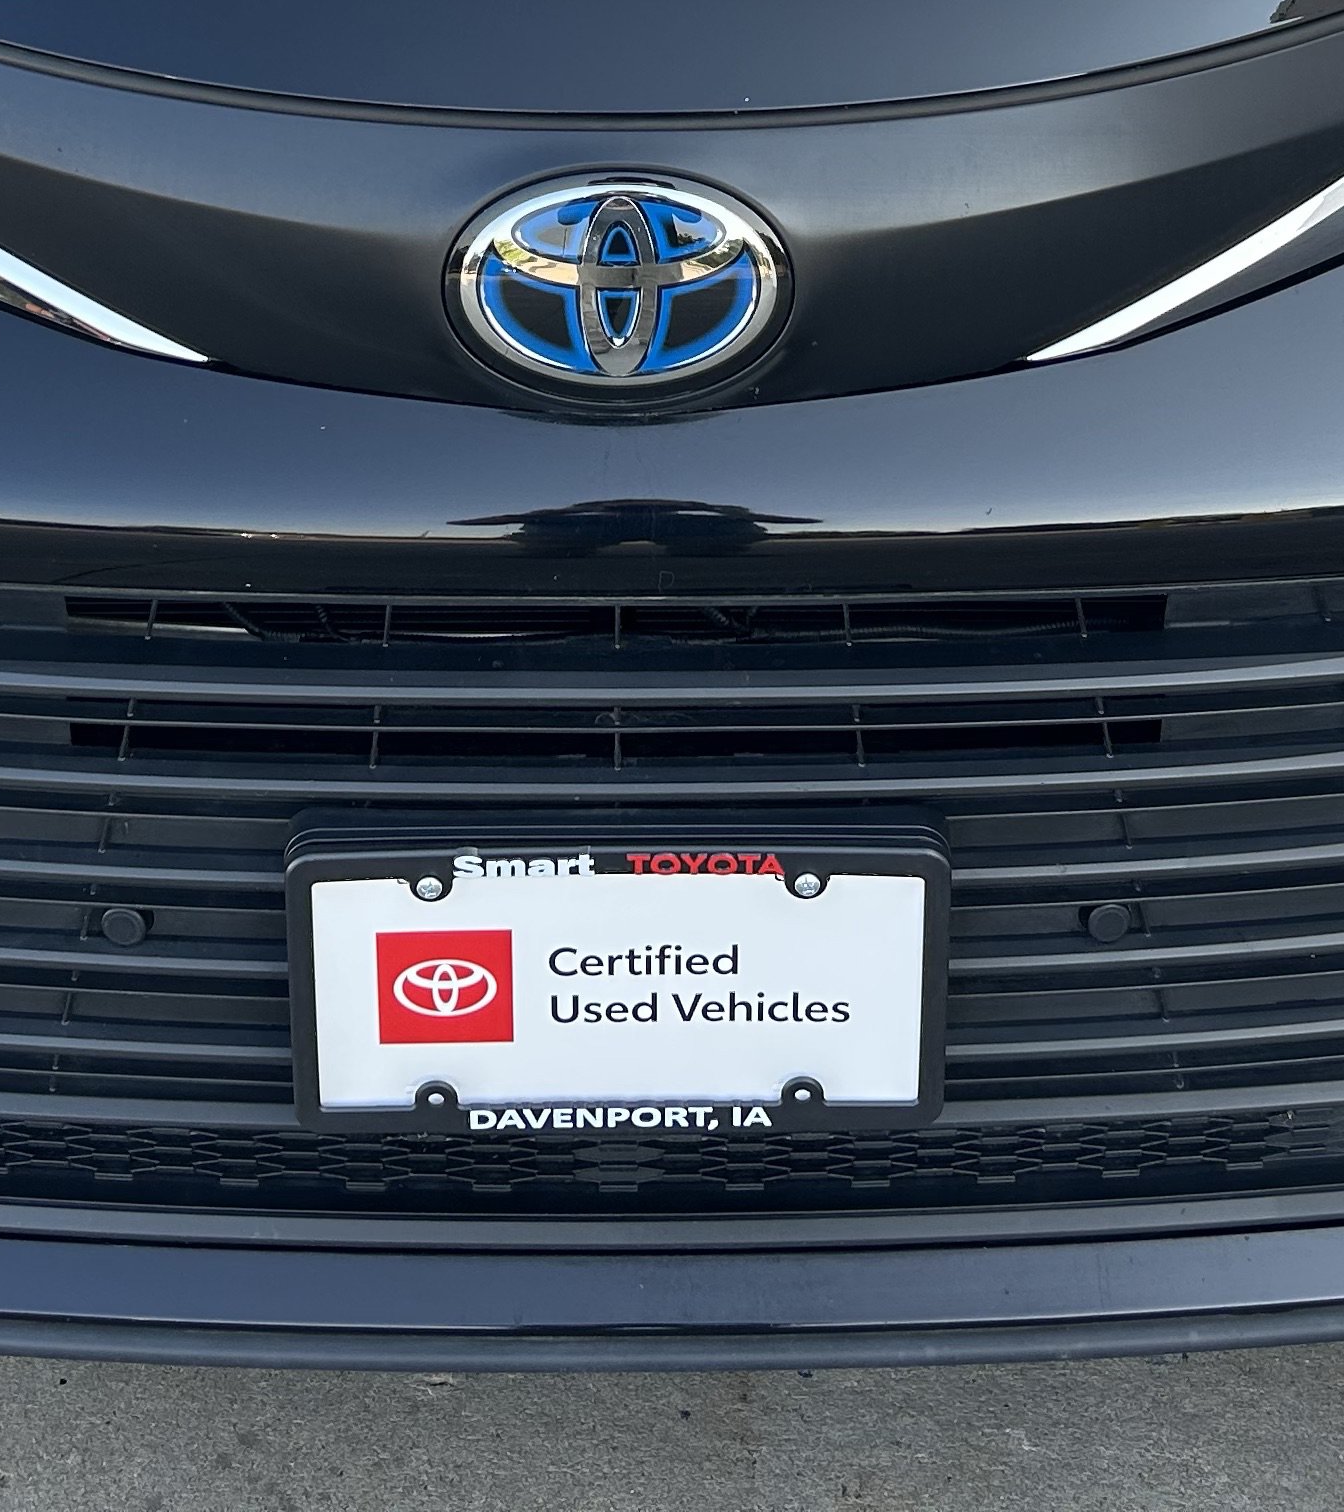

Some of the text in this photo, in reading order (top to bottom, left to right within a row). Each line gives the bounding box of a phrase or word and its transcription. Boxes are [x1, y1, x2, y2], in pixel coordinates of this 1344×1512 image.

[453, 852, 786, 878] Smart TOYOTA
[548, 944, 739, 976] Certified
[551, 990, 851, 1023] Used Vehicles
[468, 1107, 773, 1131] DAVENPORT, IA
